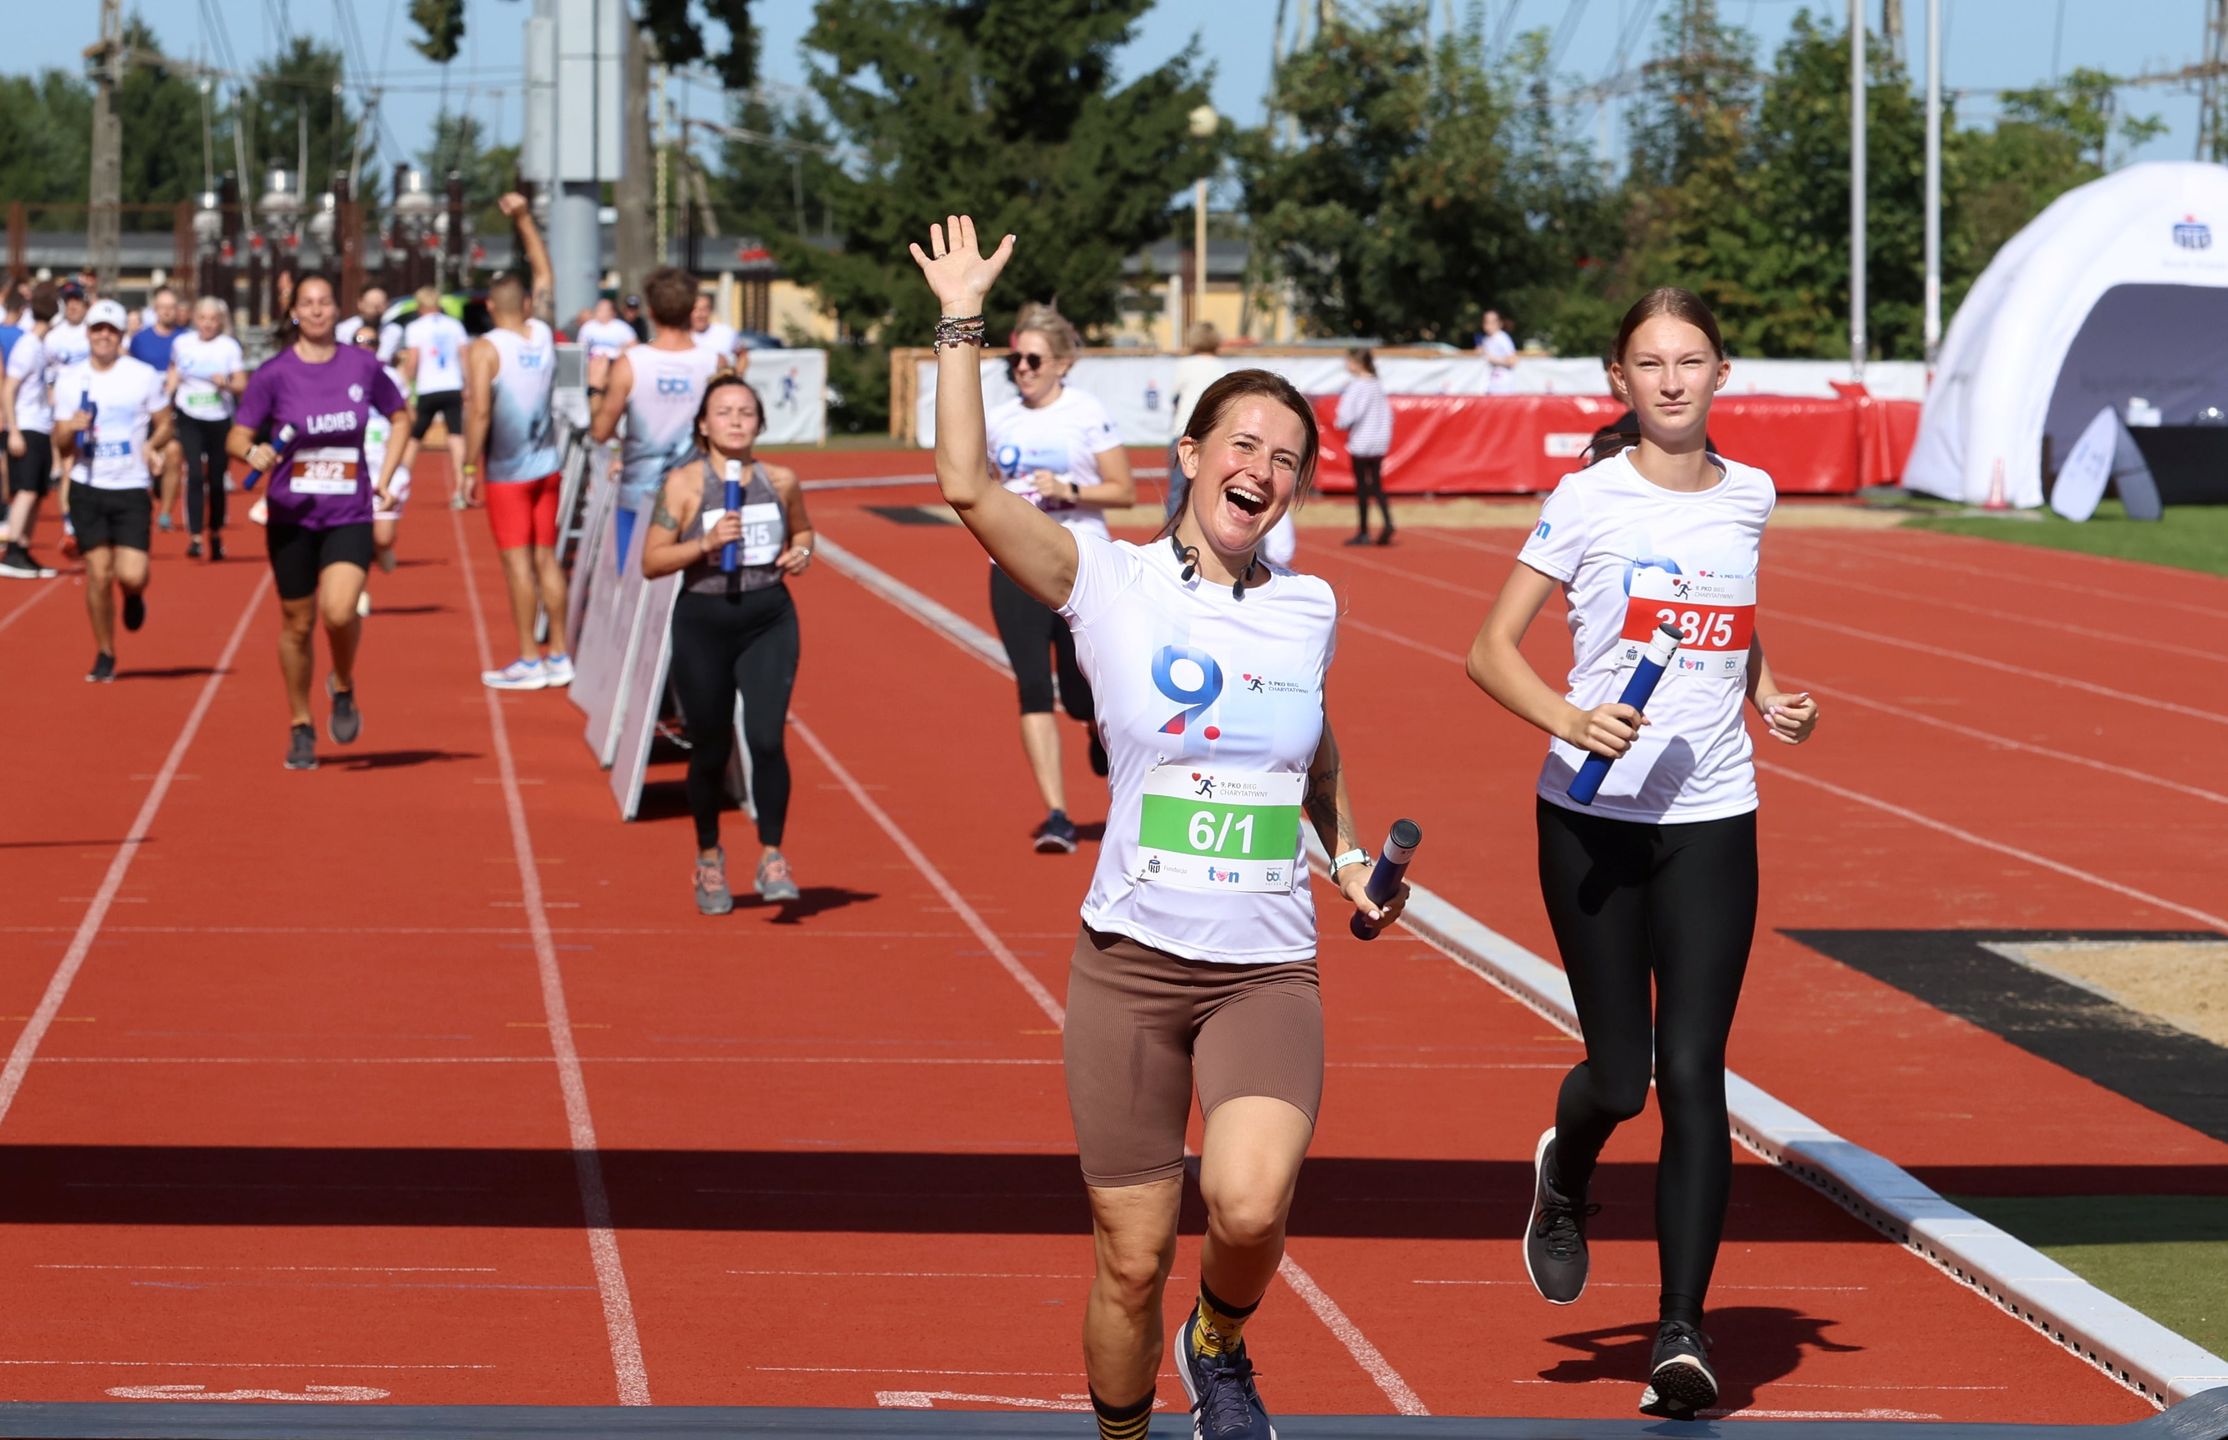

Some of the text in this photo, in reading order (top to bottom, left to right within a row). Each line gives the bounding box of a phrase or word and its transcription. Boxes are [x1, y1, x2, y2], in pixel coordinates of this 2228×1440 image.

[306, 410, 357, 434] LADIES
[1227, 782, 1241, 790] PKO
[1188, 810, 1255, 854] 6/1
